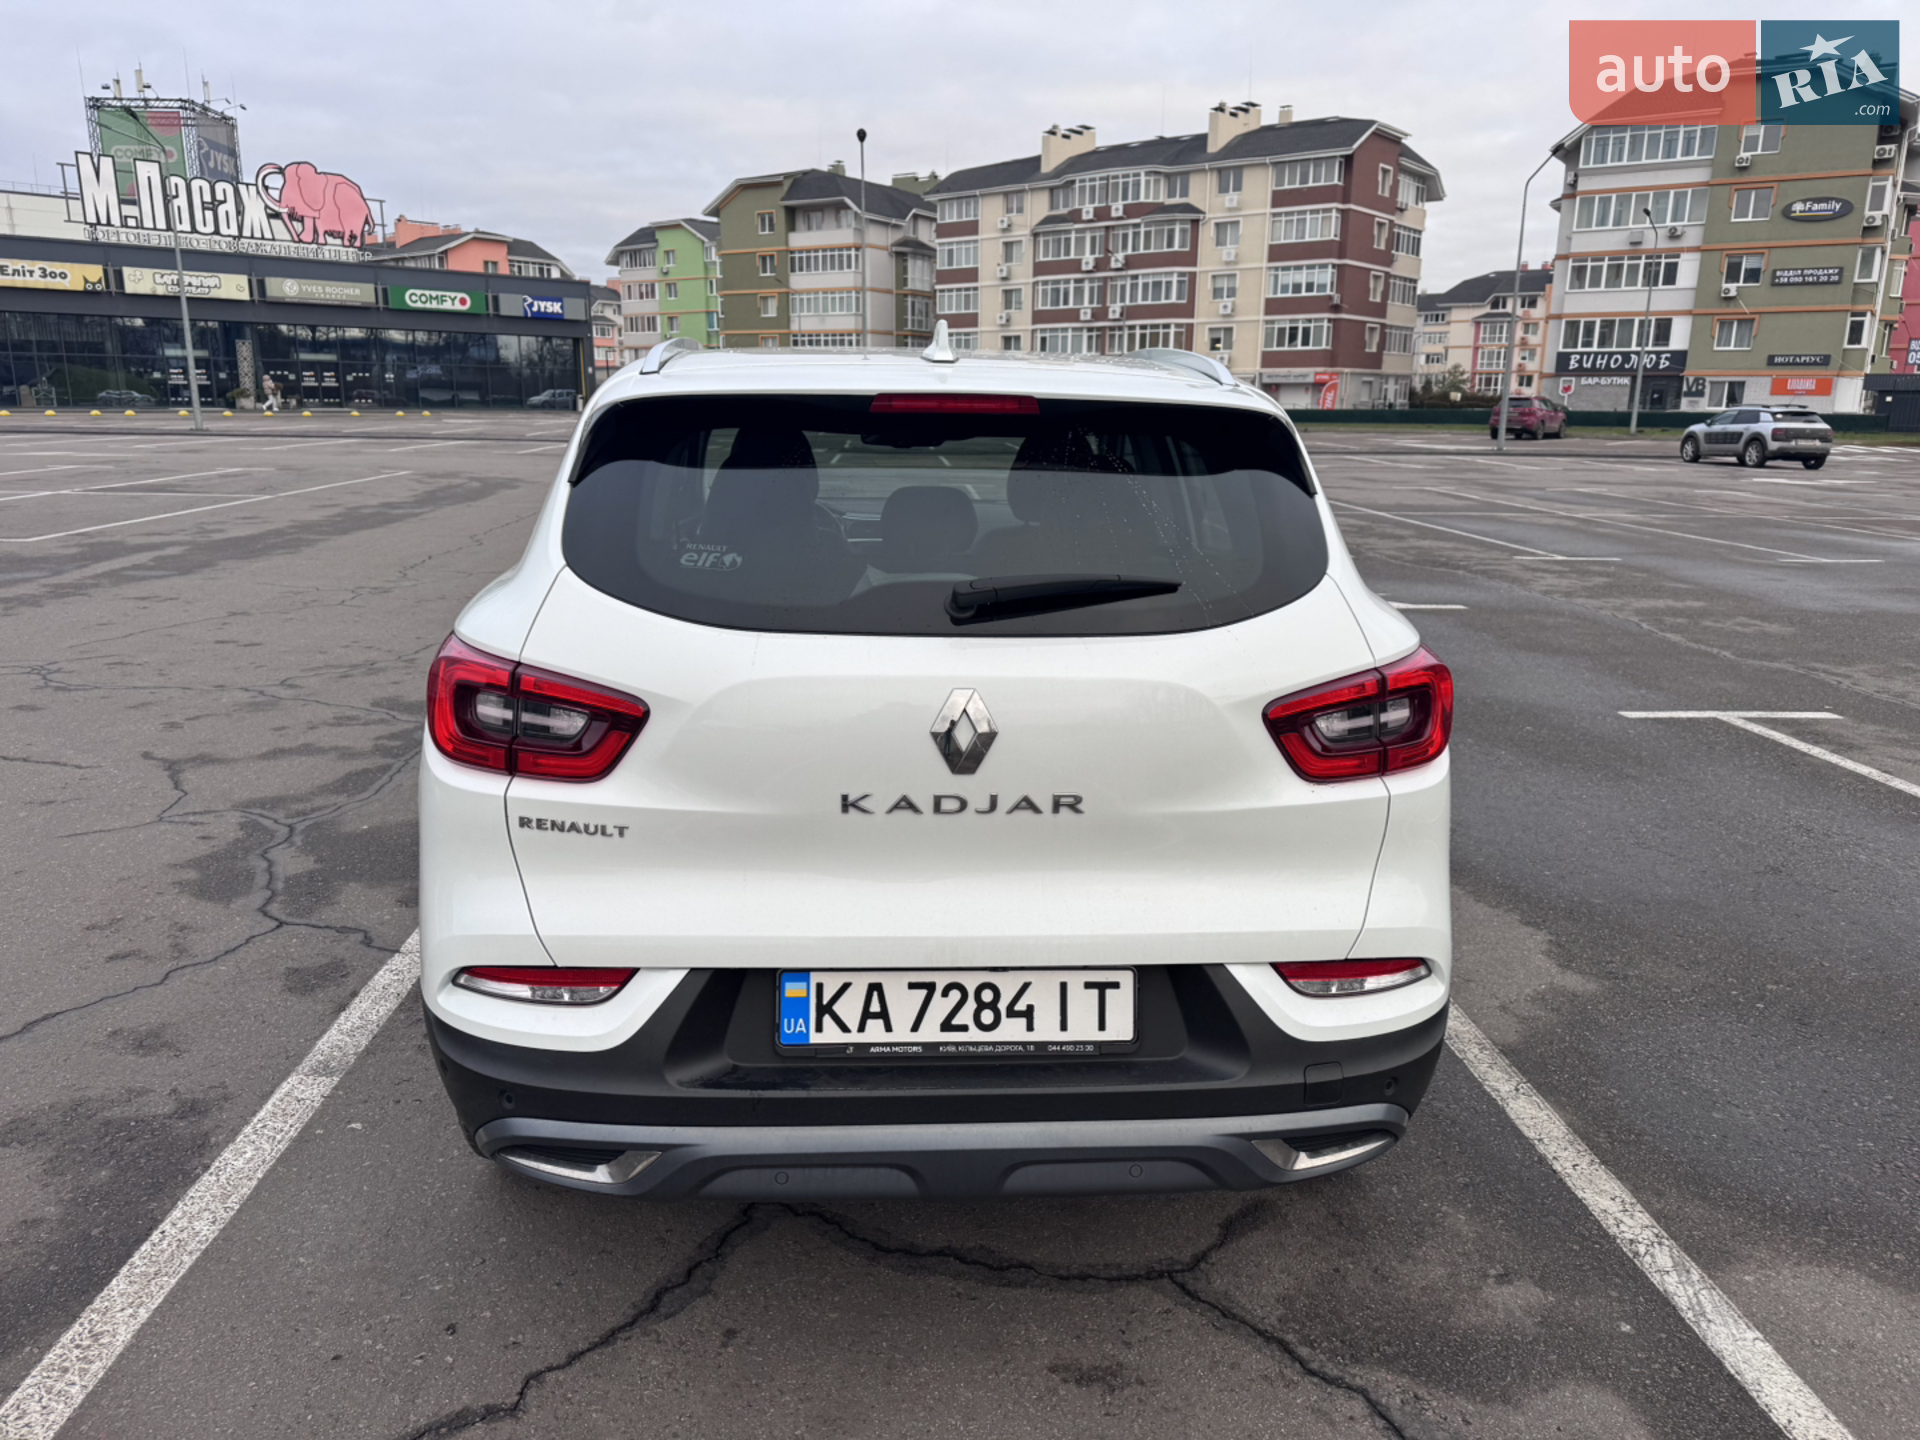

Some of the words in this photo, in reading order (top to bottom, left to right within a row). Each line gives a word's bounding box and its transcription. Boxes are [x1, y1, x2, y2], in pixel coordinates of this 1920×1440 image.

[113, 147, 164, 160] COMFY
[208, 150, 237, 177] JYSK
[1805, 200, 1842, 211] Family
[38, 266, 69, 280] Зоо
[301, 284, 324, 293] YVES
[325, 286, 361, 295] ROCHER
[408, 292, 458, 306] COMFY
[531, 301, 564, 314] JYSK
[1568, 353, 1672, 370] ВИНОЛЮБ
[1773, 355, 1825, 364] НОТАРІУС
[1580, 376, 1631, 386] БАР-БУТИК
[686, 543, 729, 552] RENAULT
[680, 552, 721, 568] elf
[839, 793, 1085, 816] KADJAR
[518, 815, 630, 838] RENAULT
[814, 981, 894, 1034] KA
[907, 981, 1035, 1033] 7284
[1059, 981, 1121, 1033] IT
[783, 1018, 807, 1034] UA
